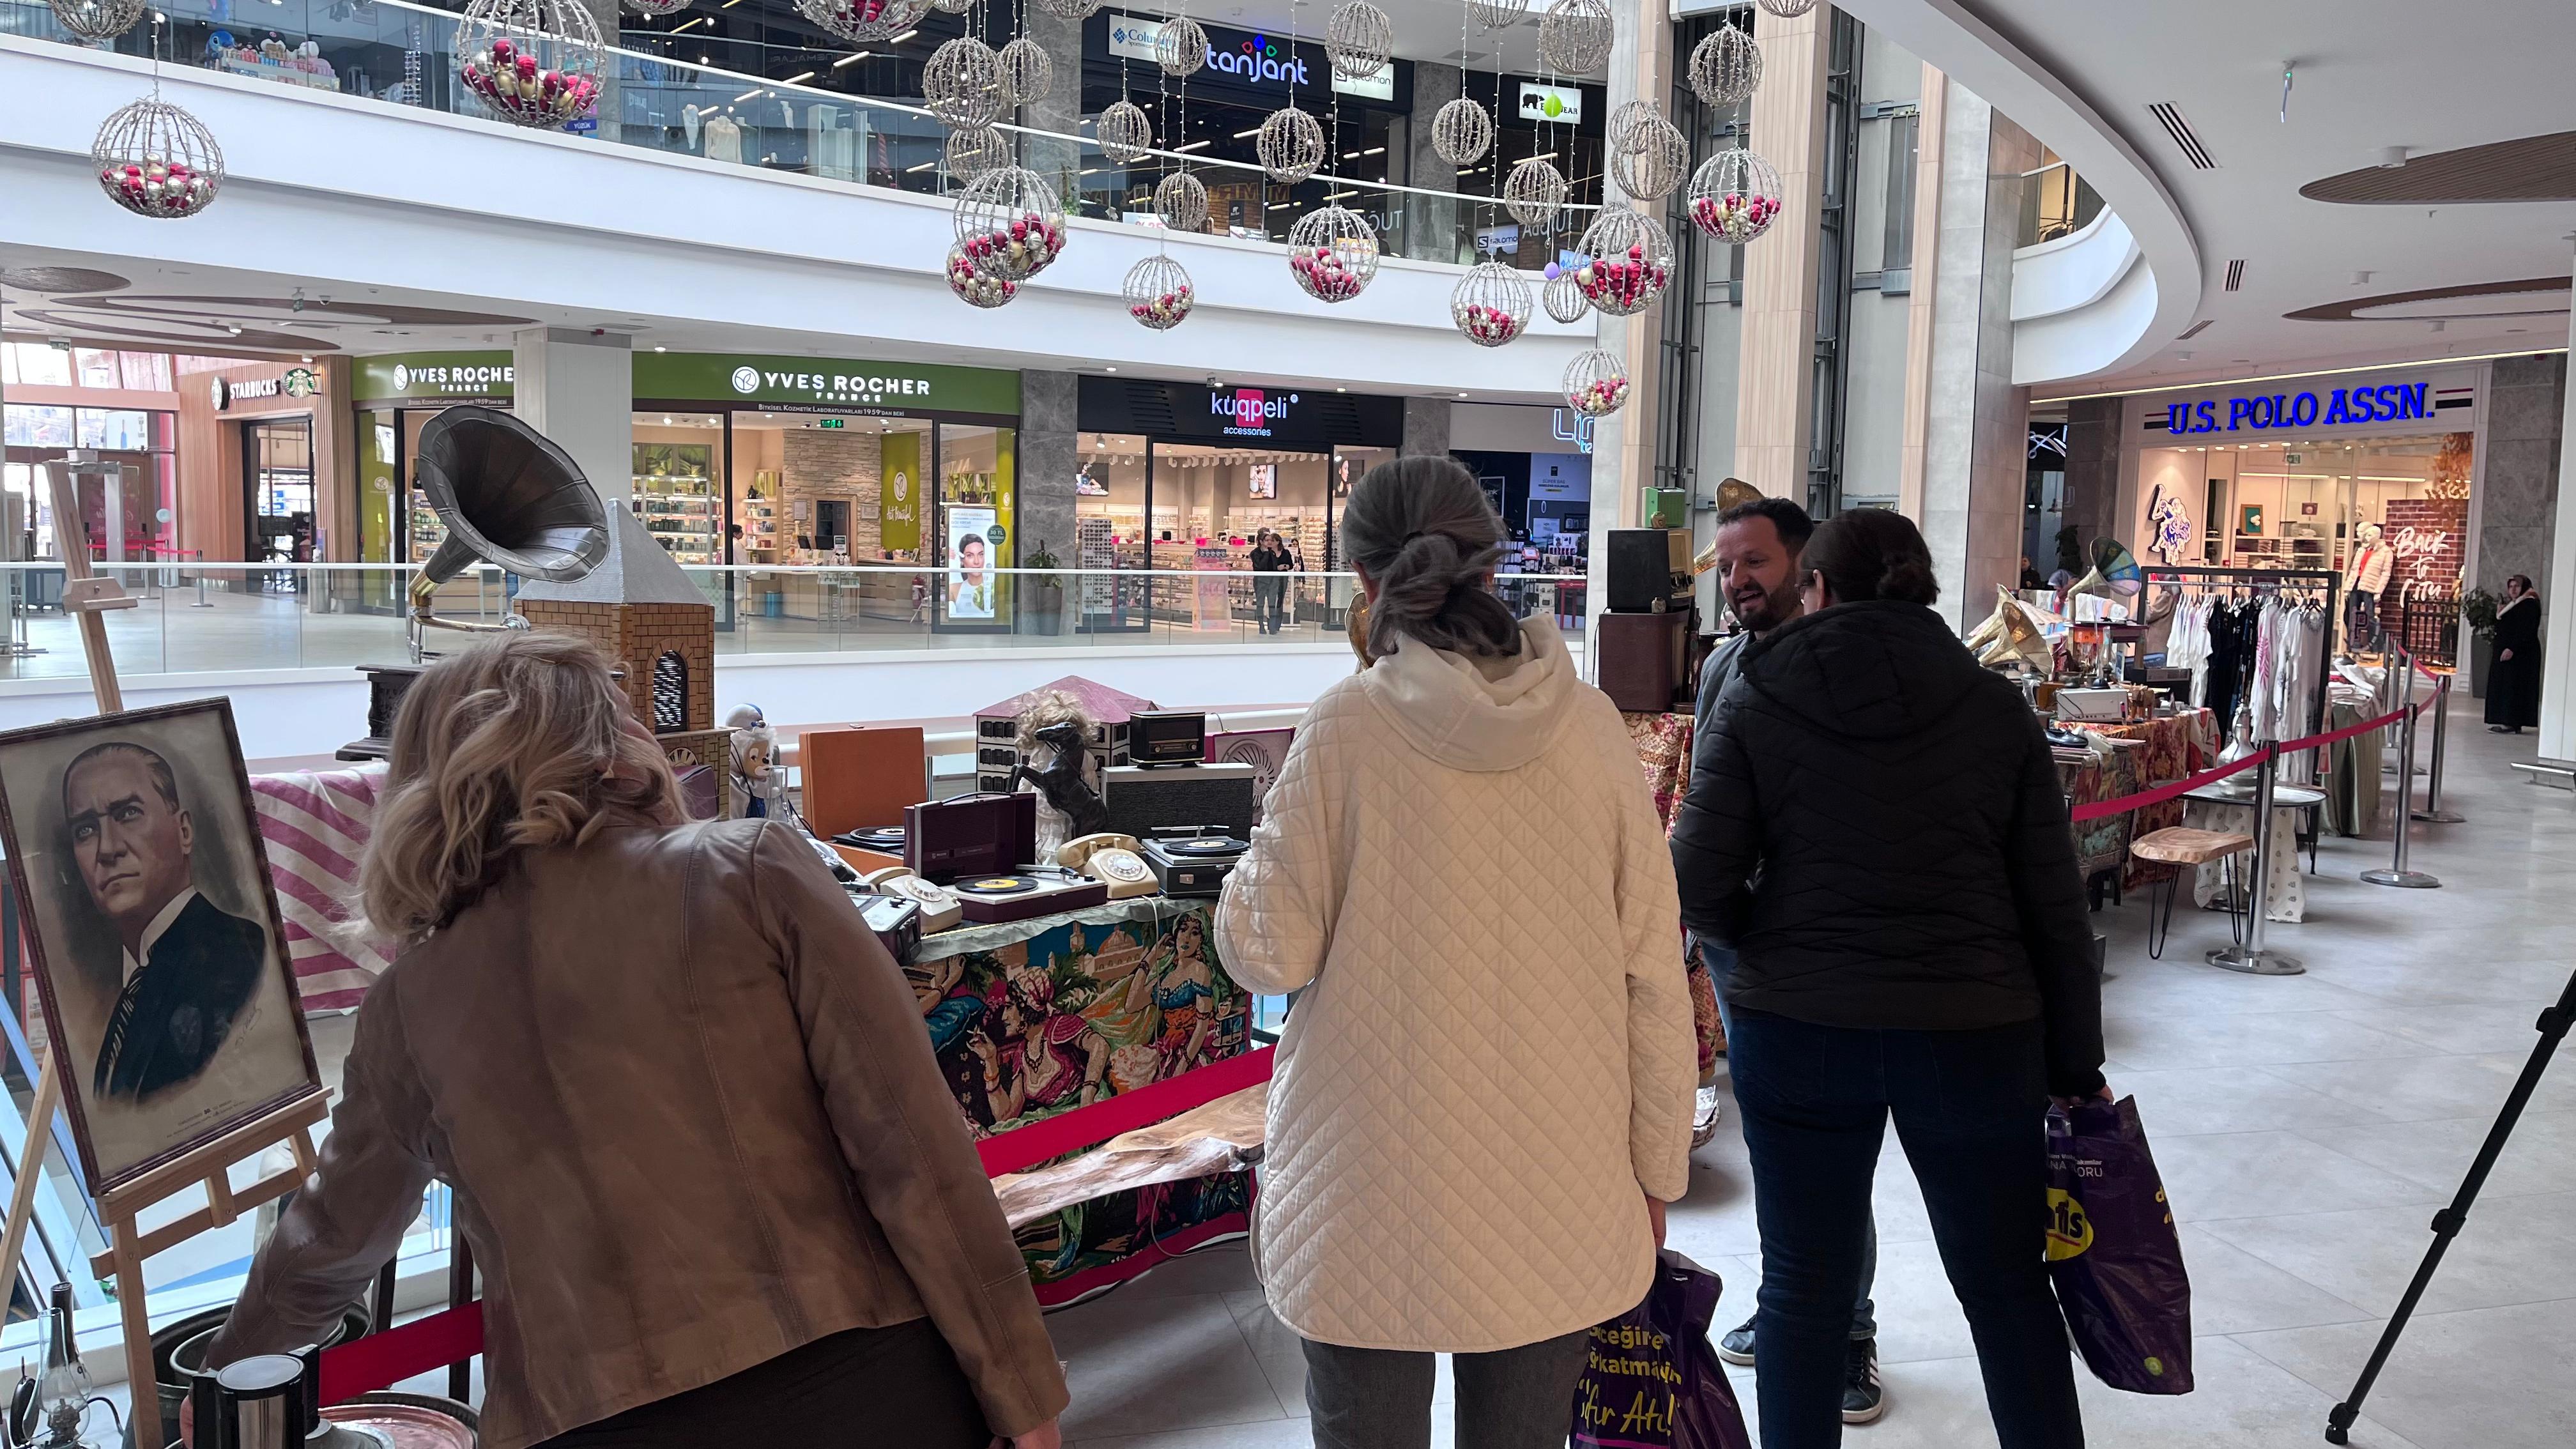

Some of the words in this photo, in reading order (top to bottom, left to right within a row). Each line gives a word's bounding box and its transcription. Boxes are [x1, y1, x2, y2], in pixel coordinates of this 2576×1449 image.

[1207, 43, 1308, 84] tanjant
[410, 367, 447, 383] YVES
[765, 372, 825, 390] YVES
[834, 375, 930, 395] ROCHER
[230, 379, 277, 399] STARBUCKS
[816, 392, 881, 402] FRANCE
[2168, 401, 2221, 434] U.S.
[2227, 392, 2319, 431] POLO
[2324, 383, 2435, 425] ASSN.
[1223, 426, 1271, 436] accessories
[2409, 555, 2435, 579] to
